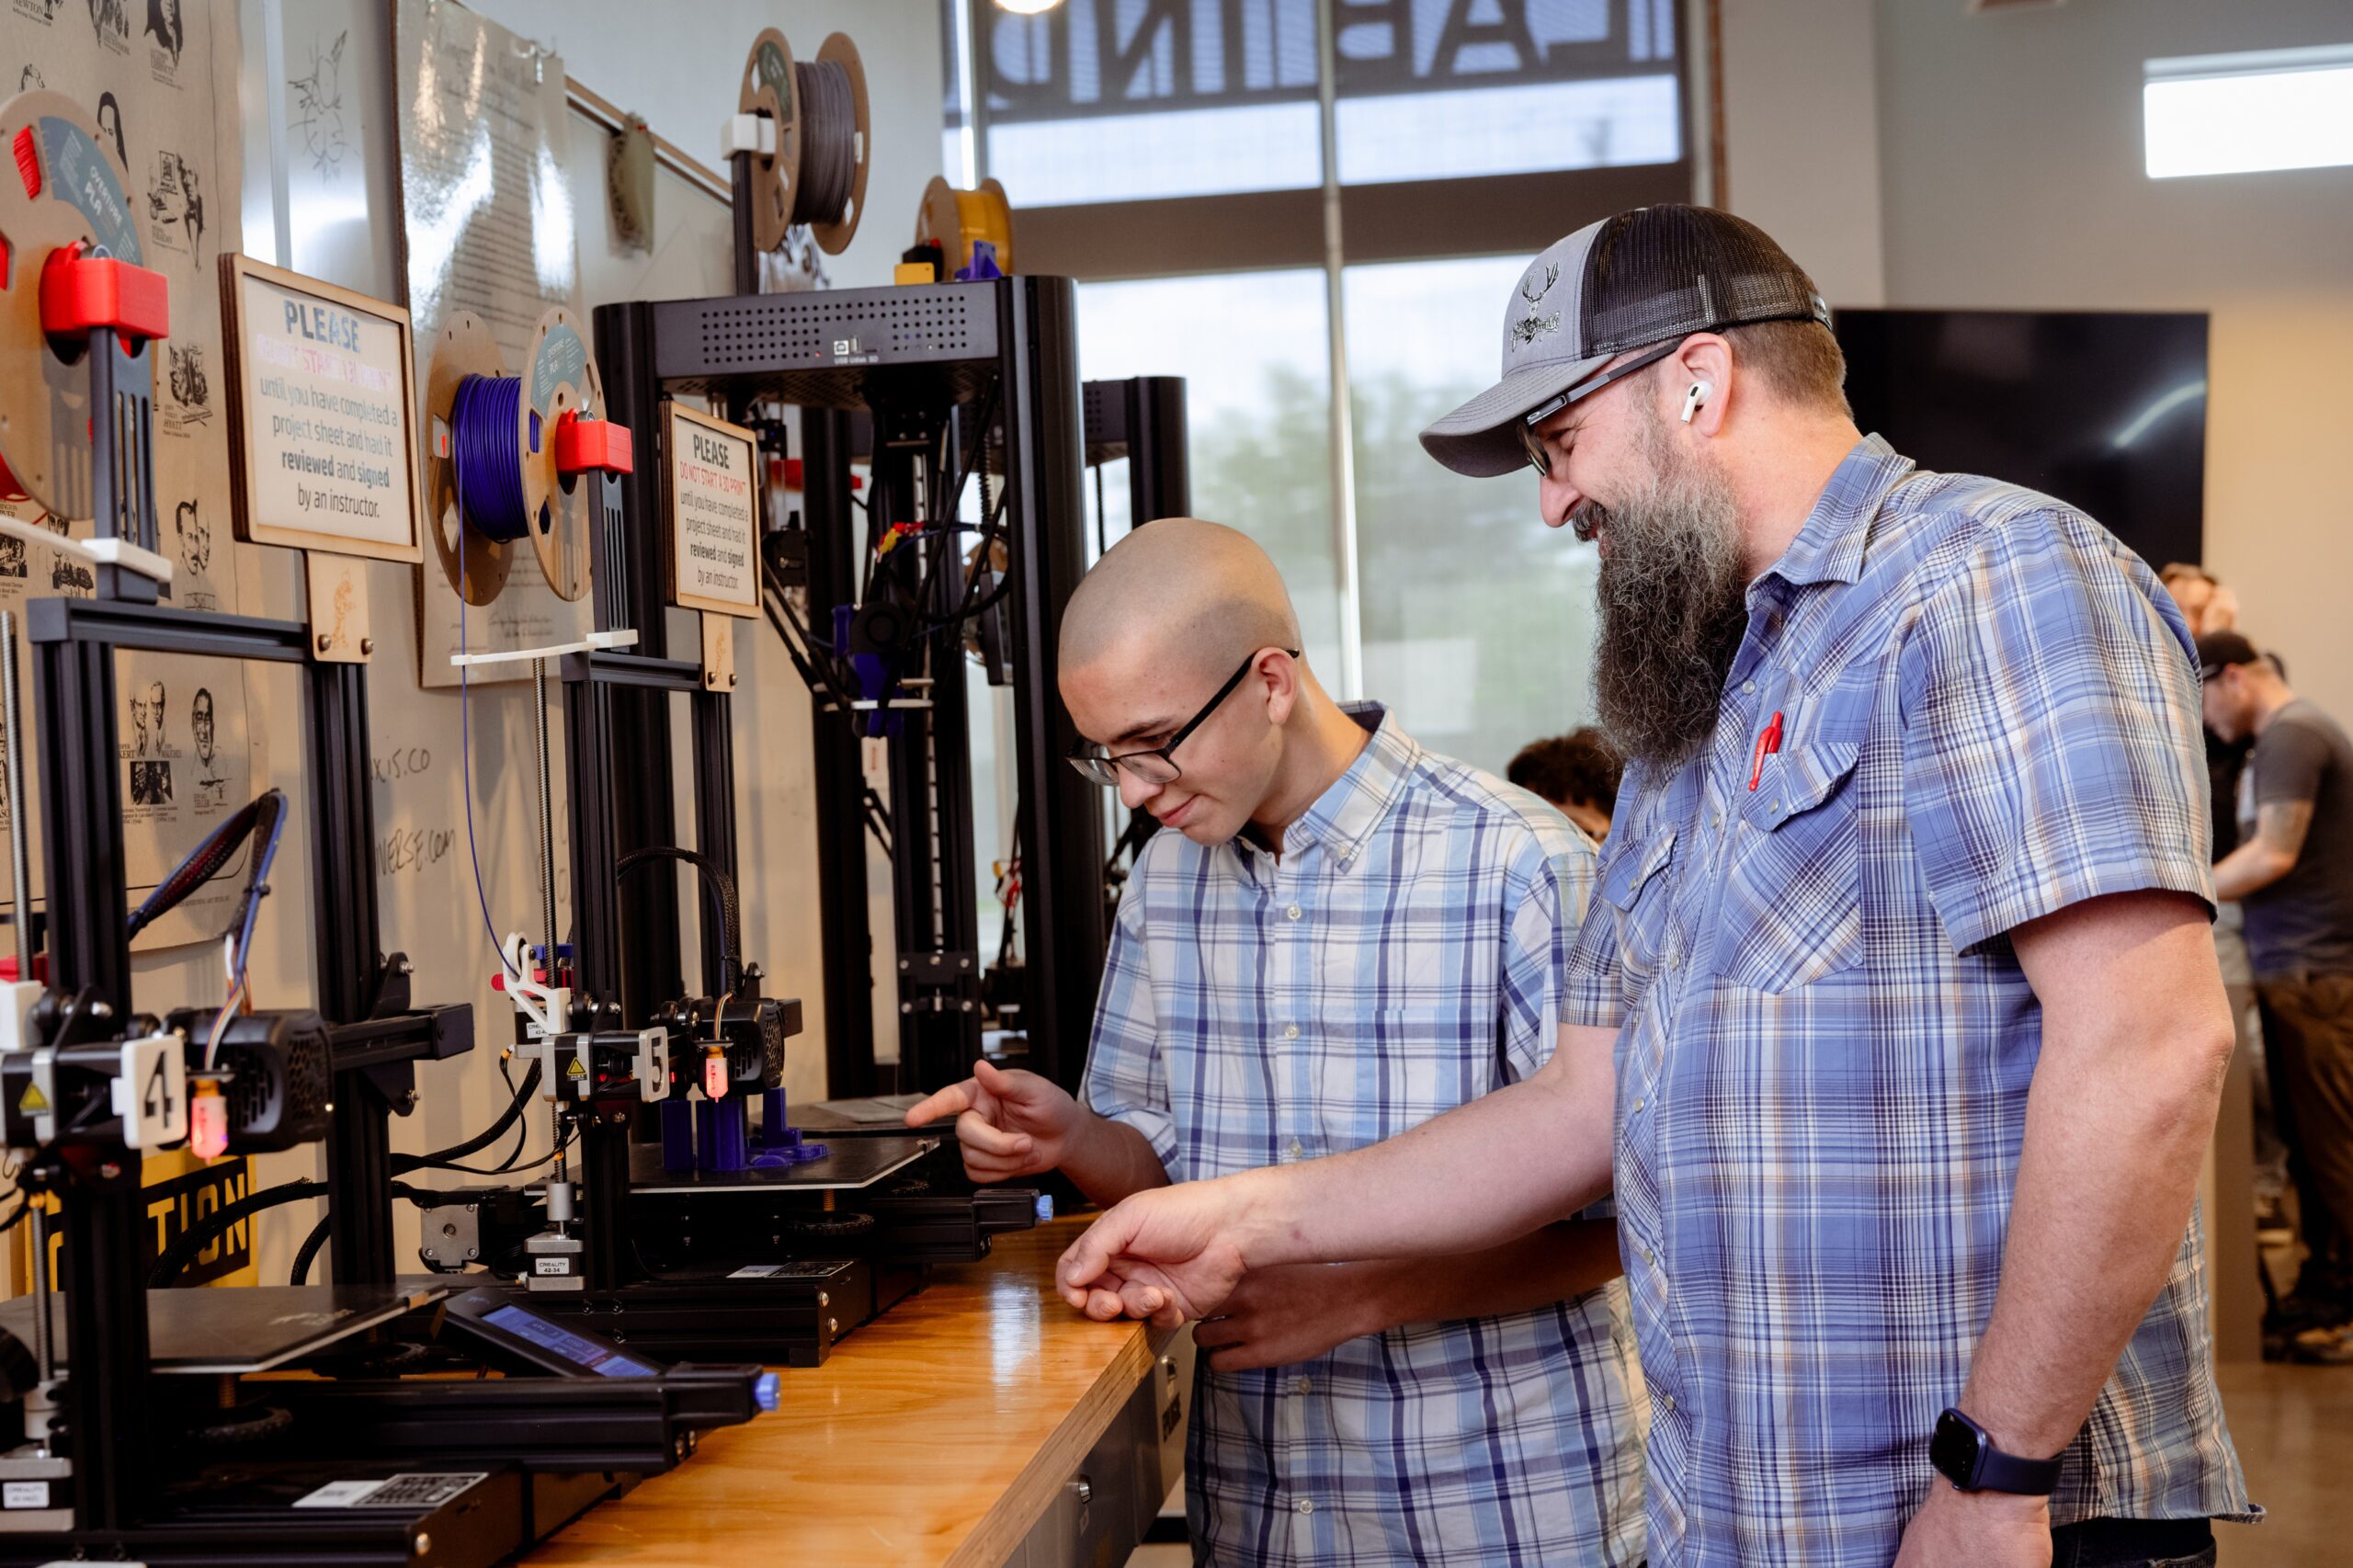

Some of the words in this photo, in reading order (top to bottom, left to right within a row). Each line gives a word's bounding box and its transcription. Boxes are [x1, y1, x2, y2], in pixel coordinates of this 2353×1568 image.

[85, 181, 102, 216] PLA
[283, 300, 361, 354] PLEASE
[260, 376, 287, 402] until
[288, 384, 309, 407] you
[311, 382, 339, 413] have
[340, 396, 390, 426] completed
[391, 410, 398, 427] a
[272, 415, 313, 441] project
[314, 419, 346, 447] sheet
[347, 428, 364, 451] and
[365, 431, 383, 456] had
[384, 435, 393, 458] it
[693, 434, 730, 470] PLEASE
[281, 449, 335, 477] reviewed
[336, 460, 356, 482] and
[357, 462, 391, 490] signed
[680, 460, 688, 480] DO
[688, 464, 699, 484] NOT
[700, 468, 717, 489] START
[730, 477, 746, 496] PRINT
[298, 483, 312, 512] by
[313, 490, 327, 509] an
[329, 489, 380, 518] instructor.
[680, 491, 693, 507] until
[694, 496, 705, 512] you
[705, 494, 718, 514] have
[686, 517, 706, 536] project
[706, 520, 722, 539] sheet
[722, 525, 731, 541] and
[690, 541, 716, 561] reviewed
[717, 548, 727, 563] and
[727, 549, 745, 569] signed
[698, 566, 704, 586] by
[705, 571, 712, 585] an
[371, 748, 430, 783] XIS.CO
[651, 1036, 664, 1094] 5
[144, 1050, 173, 1130] 4
